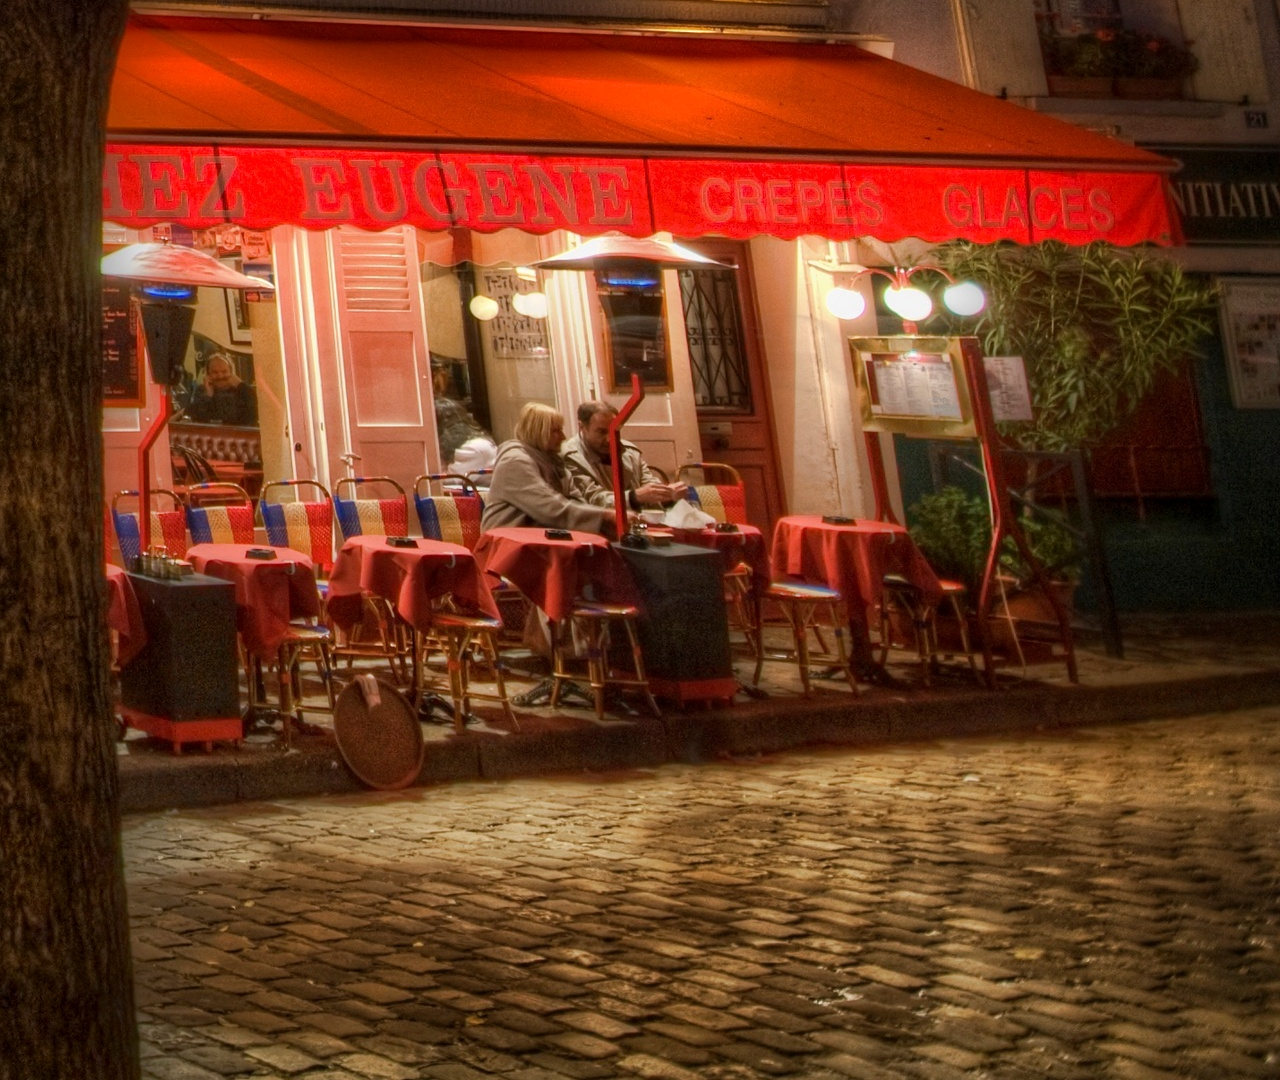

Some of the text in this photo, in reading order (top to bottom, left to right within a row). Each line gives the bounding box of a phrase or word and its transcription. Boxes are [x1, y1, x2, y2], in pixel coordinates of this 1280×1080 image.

[293, 157, 634, 226] EUGENE
[700, 177, 884, 227] CREPES
[943, 183, 1116, 232] GLACES
